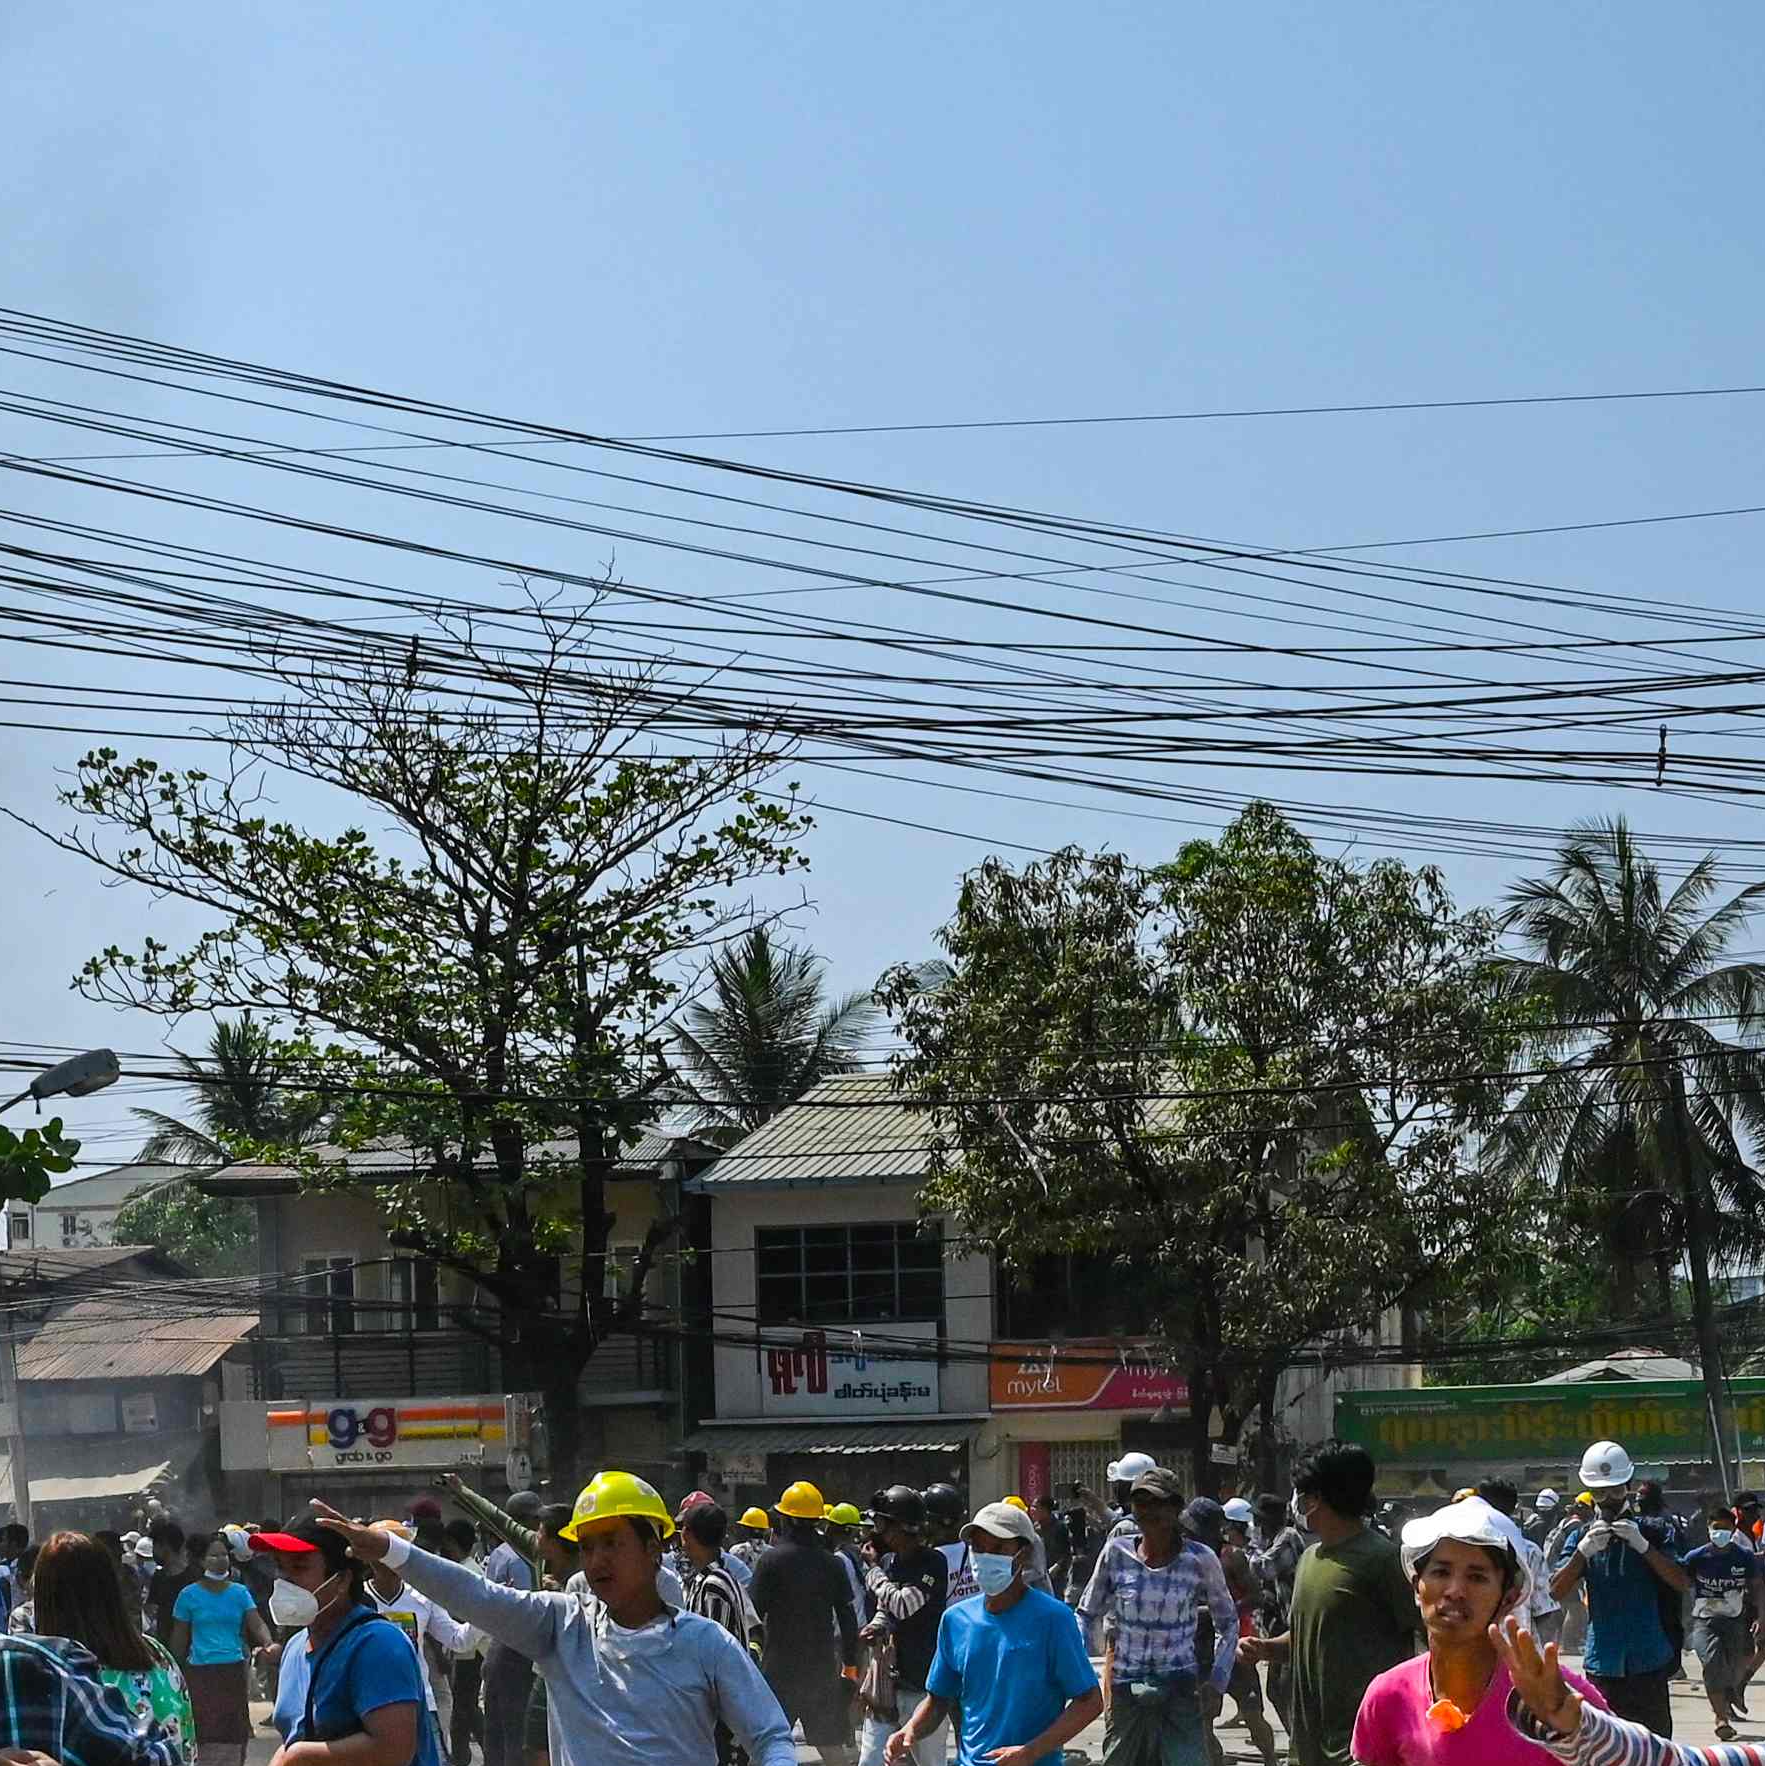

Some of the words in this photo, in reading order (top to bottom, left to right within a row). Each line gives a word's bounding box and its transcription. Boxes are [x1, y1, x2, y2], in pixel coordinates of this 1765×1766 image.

[1007, 1375, 1062, 1397] mytel
[335, 1450, 364, 1465] grab
[376, 1450, 393, 1465] go
